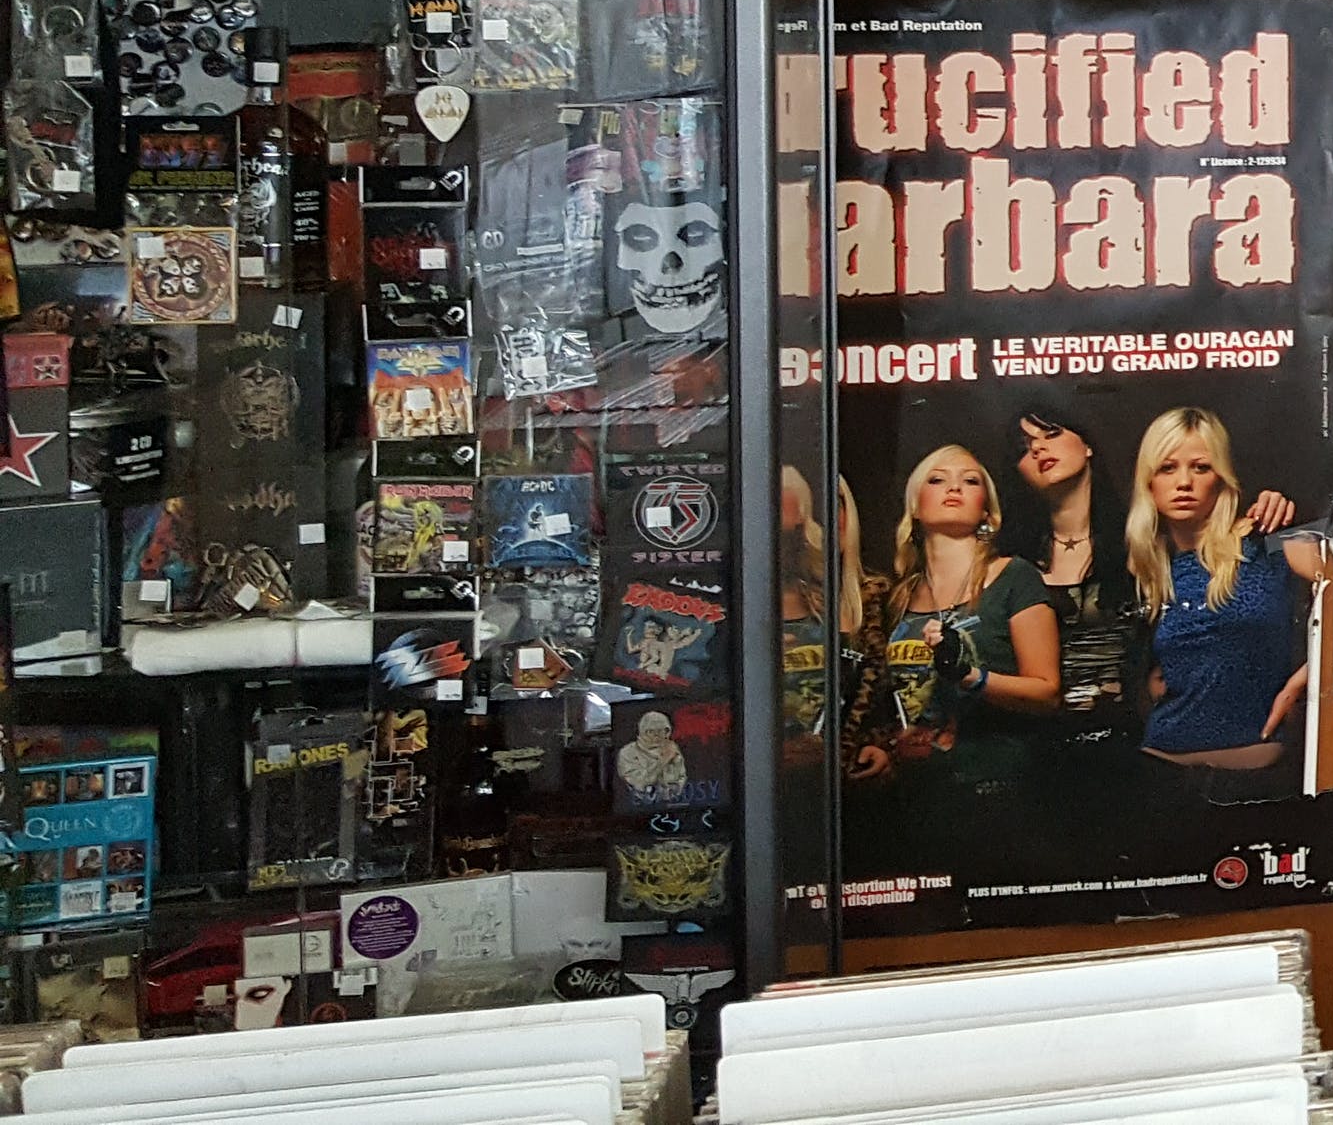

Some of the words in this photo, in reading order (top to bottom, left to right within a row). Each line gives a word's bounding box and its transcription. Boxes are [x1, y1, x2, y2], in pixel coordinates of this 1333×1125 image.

[871, 20, 899, 31] Bad
[903, 20, 983, 34] Reputation
[993, 338, 1024, 357] LE
[1032, 334, 1168, 356] VERITABLE
[1173, 330, 1295, 350] OURAGAN
[993, 357, 1061, 376] VENU
[1068, 356, 1098, 373] DU
[1103, 352, 1200, 372] GRAND
[1205, 350, 1281, 370] FROID
[897, 878, 917, 889] We
[919, 876, 952, 887] Trust
